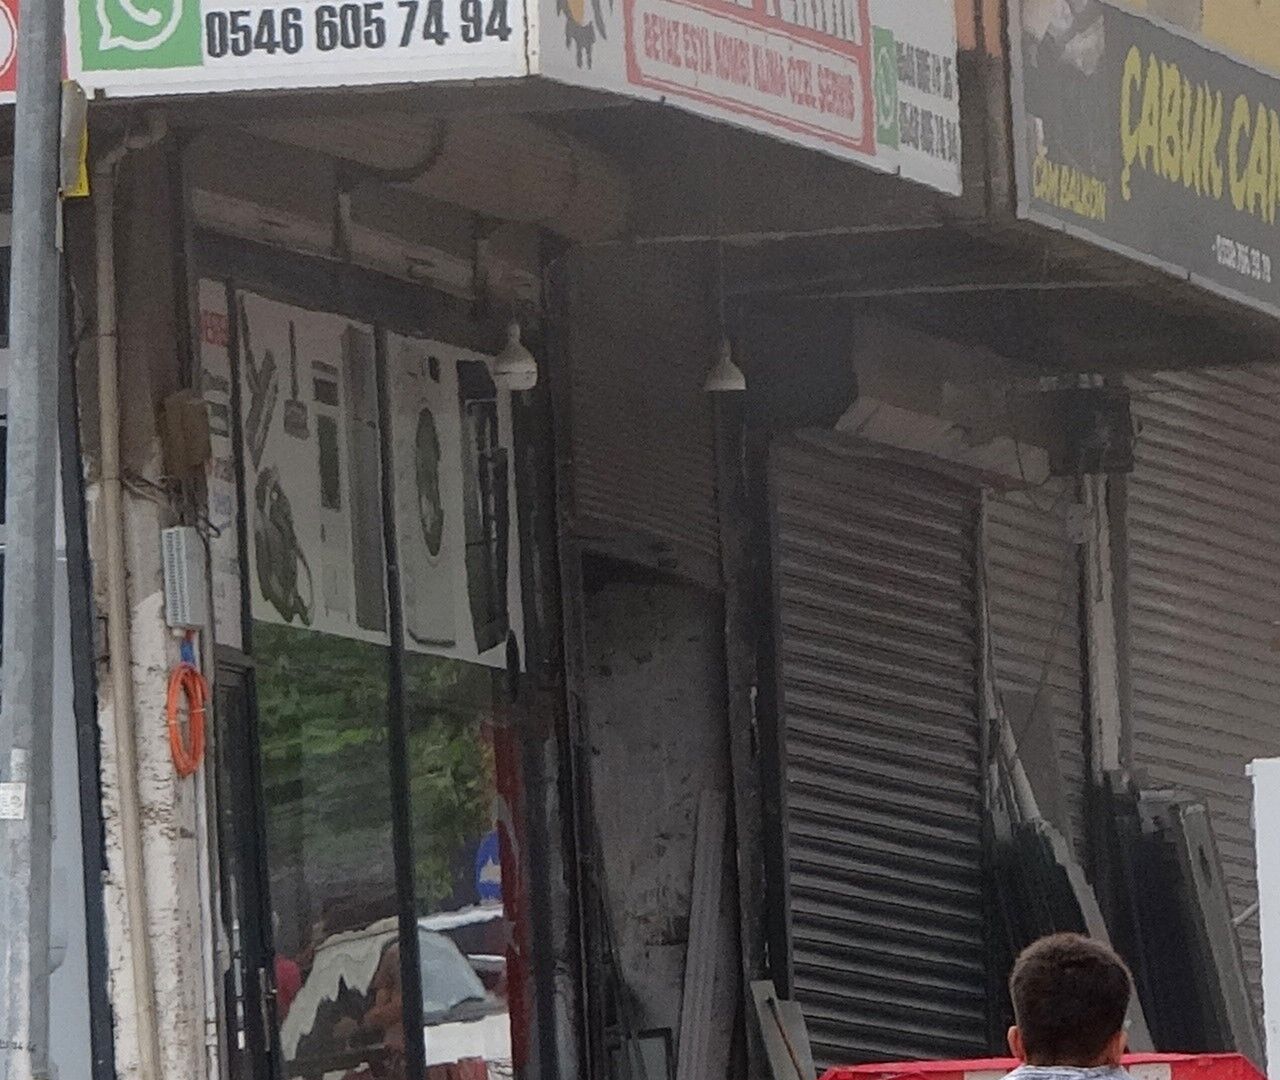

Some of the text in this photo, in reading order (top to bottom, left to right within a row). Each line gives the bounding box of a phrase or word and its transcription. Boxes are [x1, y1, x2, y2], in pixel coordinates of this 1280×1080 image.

[206, 0, 512, 57] 0546 605 74 94
[1121, 45, 1223, 200] ÇABUK
